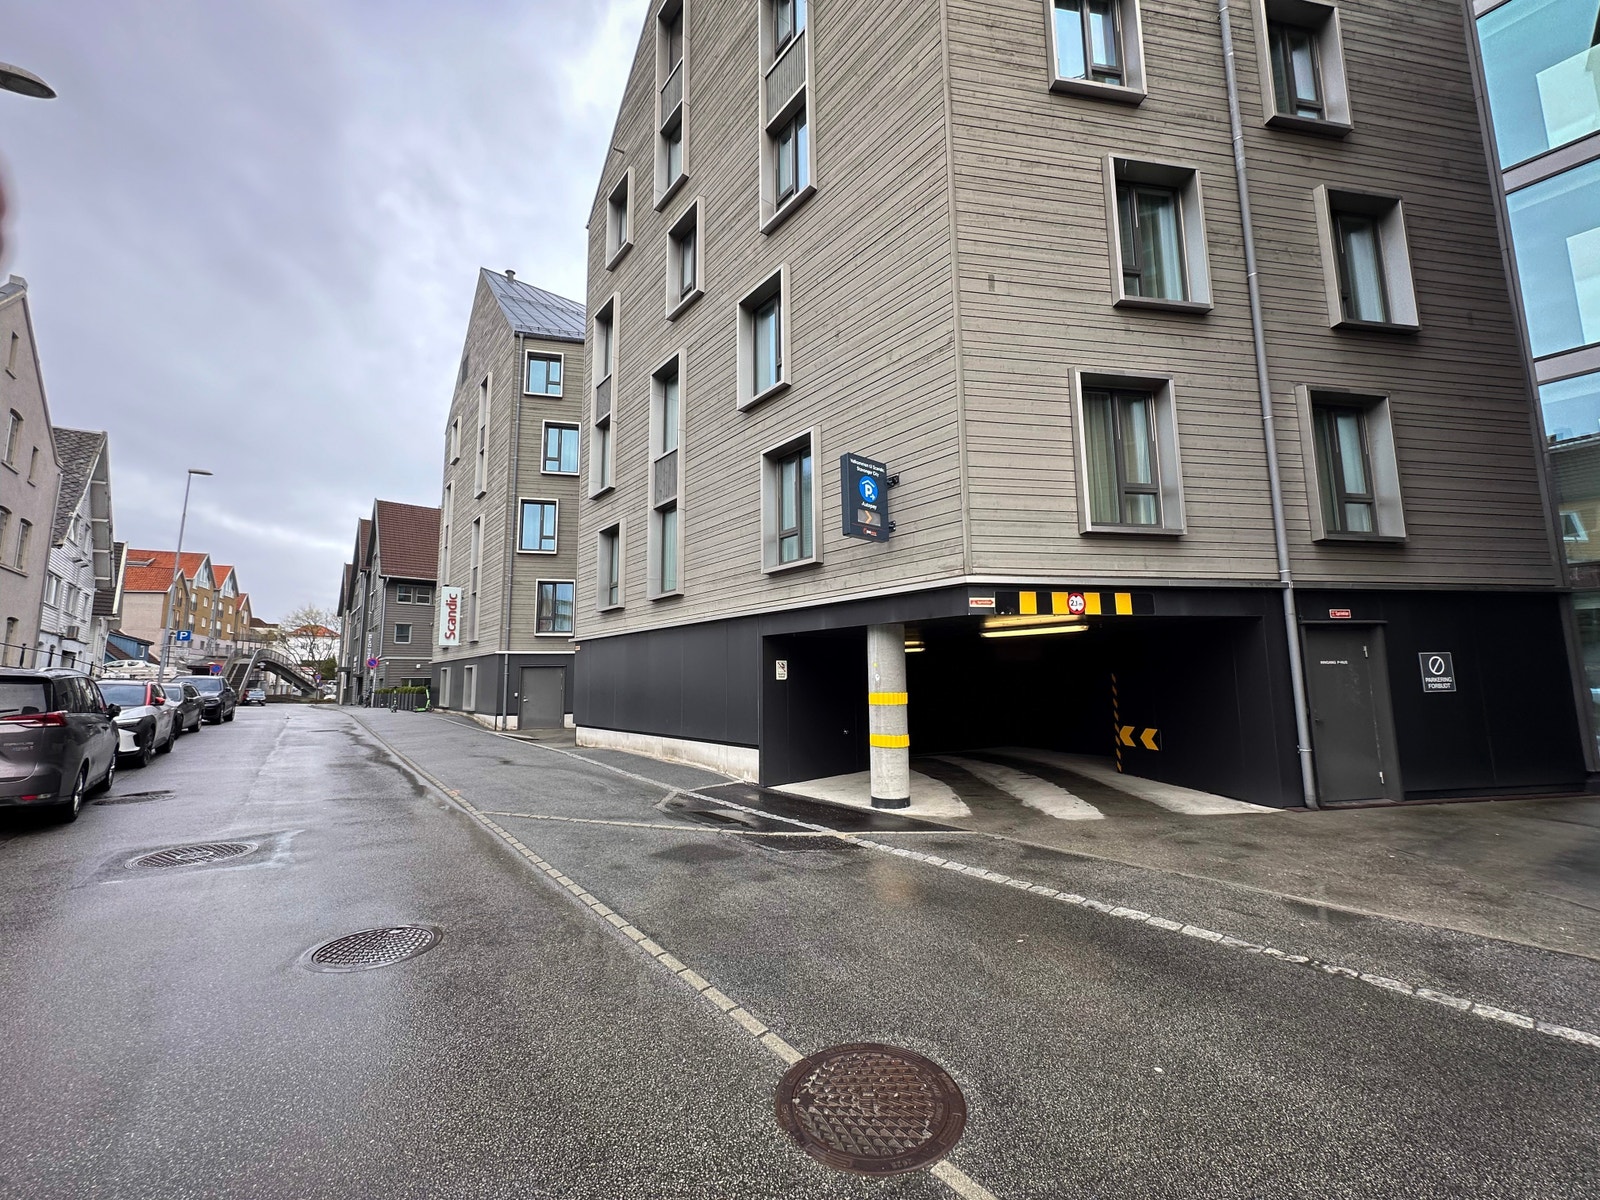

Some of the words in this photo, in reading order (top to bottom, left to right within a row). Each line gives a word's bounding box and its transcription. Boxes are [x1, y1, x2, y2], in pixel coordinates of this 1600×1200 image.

[865, 484, 873, 497] P
[445, 593, 457, 640] Scandic
[180, 632, 188, 640] P
